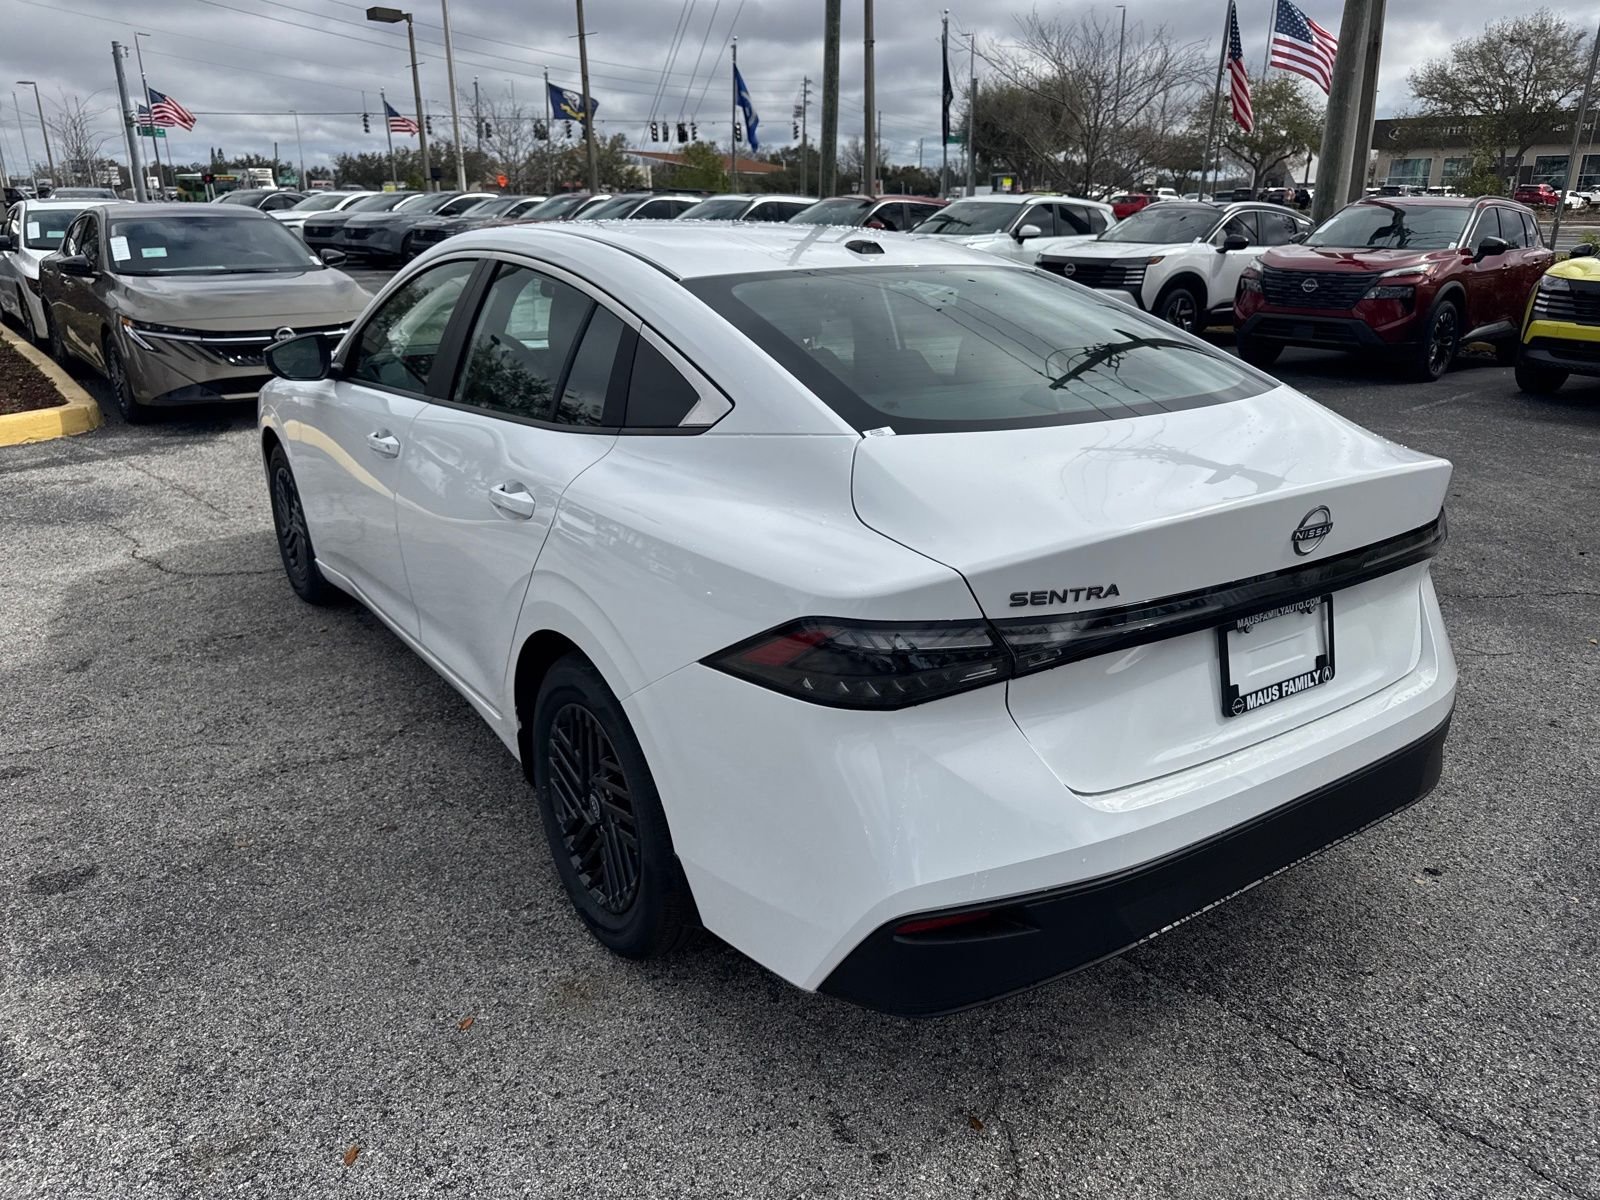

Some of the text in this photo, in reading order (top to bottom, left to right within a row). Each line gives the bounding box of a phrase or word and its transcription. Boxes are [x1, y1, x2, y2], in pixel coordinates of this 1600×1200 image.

[1009, 583, 1120, 607] SENTRA
[1237, 597, 1321, 628] MAUSFAMILYAUTO.COM
[1246, 670, 1321, 710] MAUS FAMILY
